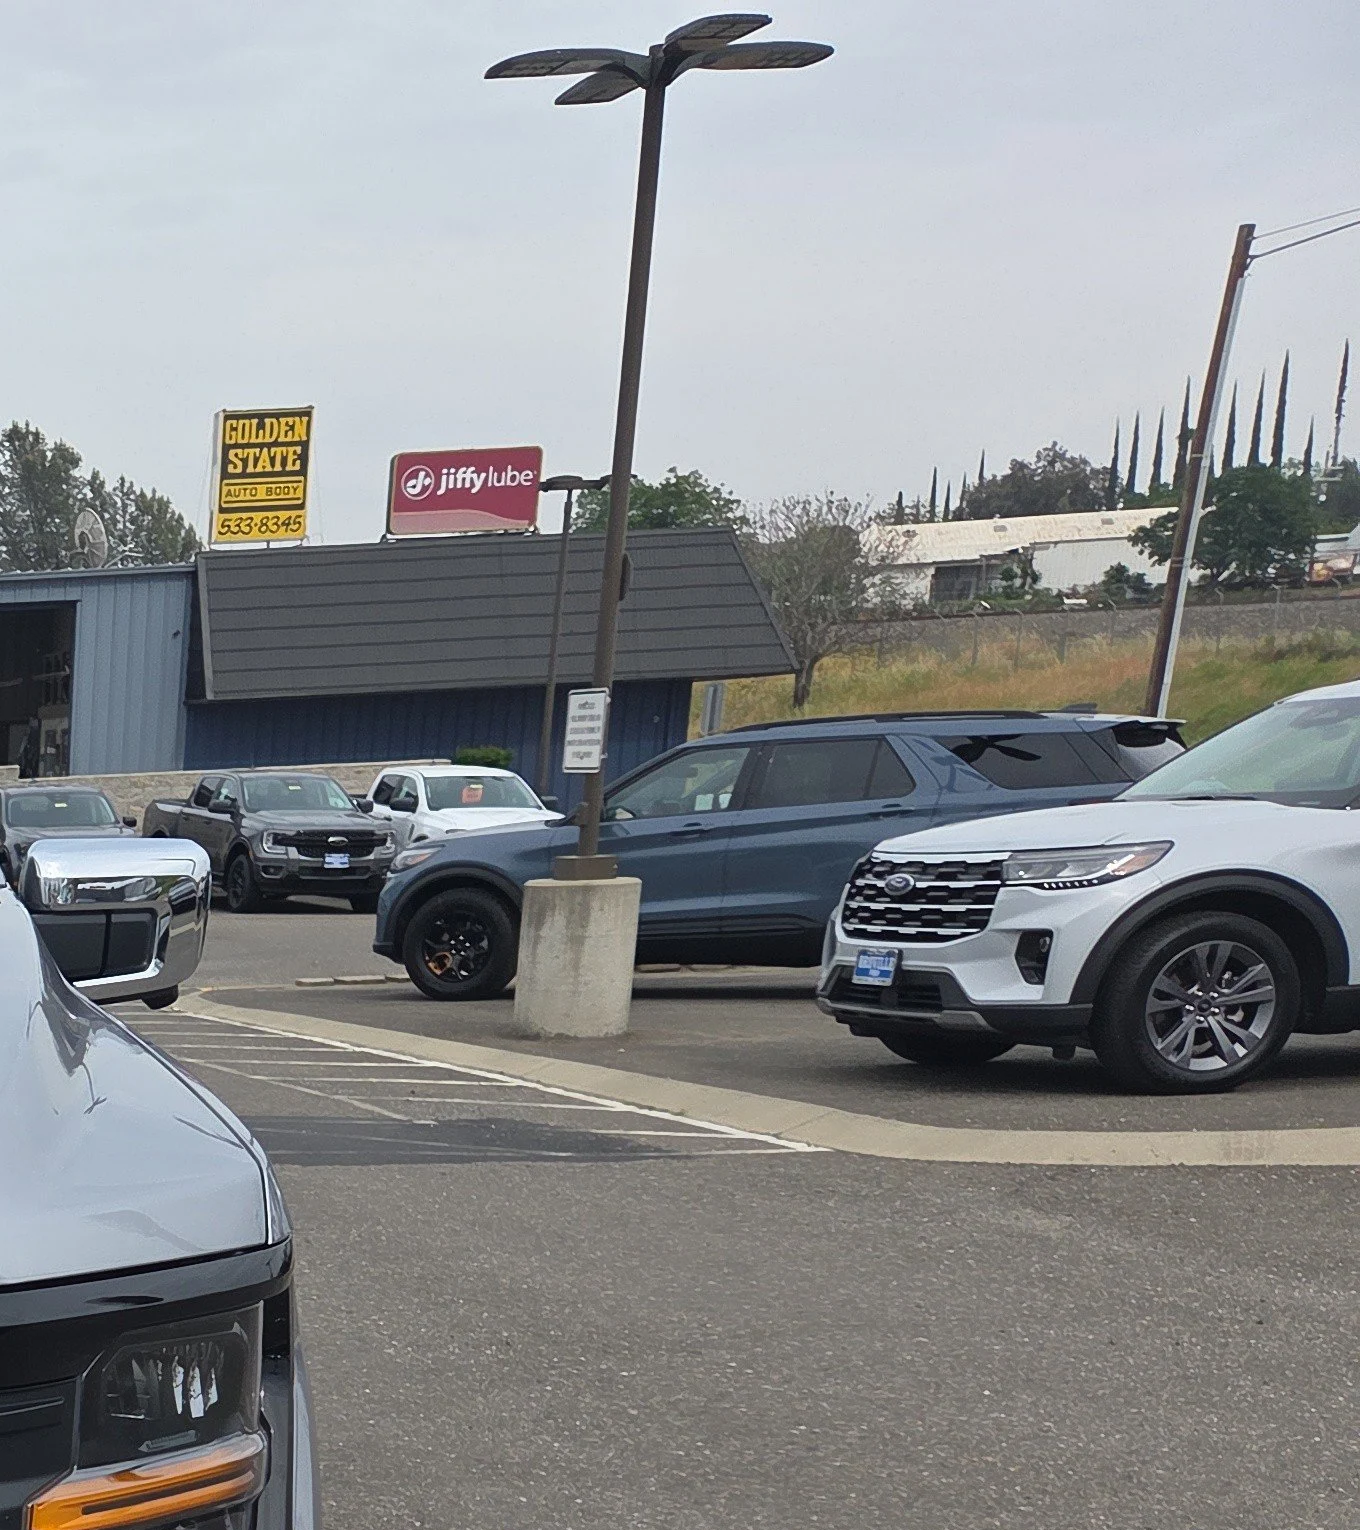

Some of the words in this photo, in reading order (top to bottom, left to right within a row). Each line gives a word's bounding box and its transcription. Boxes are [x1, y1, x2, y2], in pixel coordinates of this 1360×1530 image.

[224, 416, 309, 445] GOLDEN
[227, 446, 302, 474] STATE
[224, 486, 259, 499] AUTO
[264, 484, 300, 496] BODY
